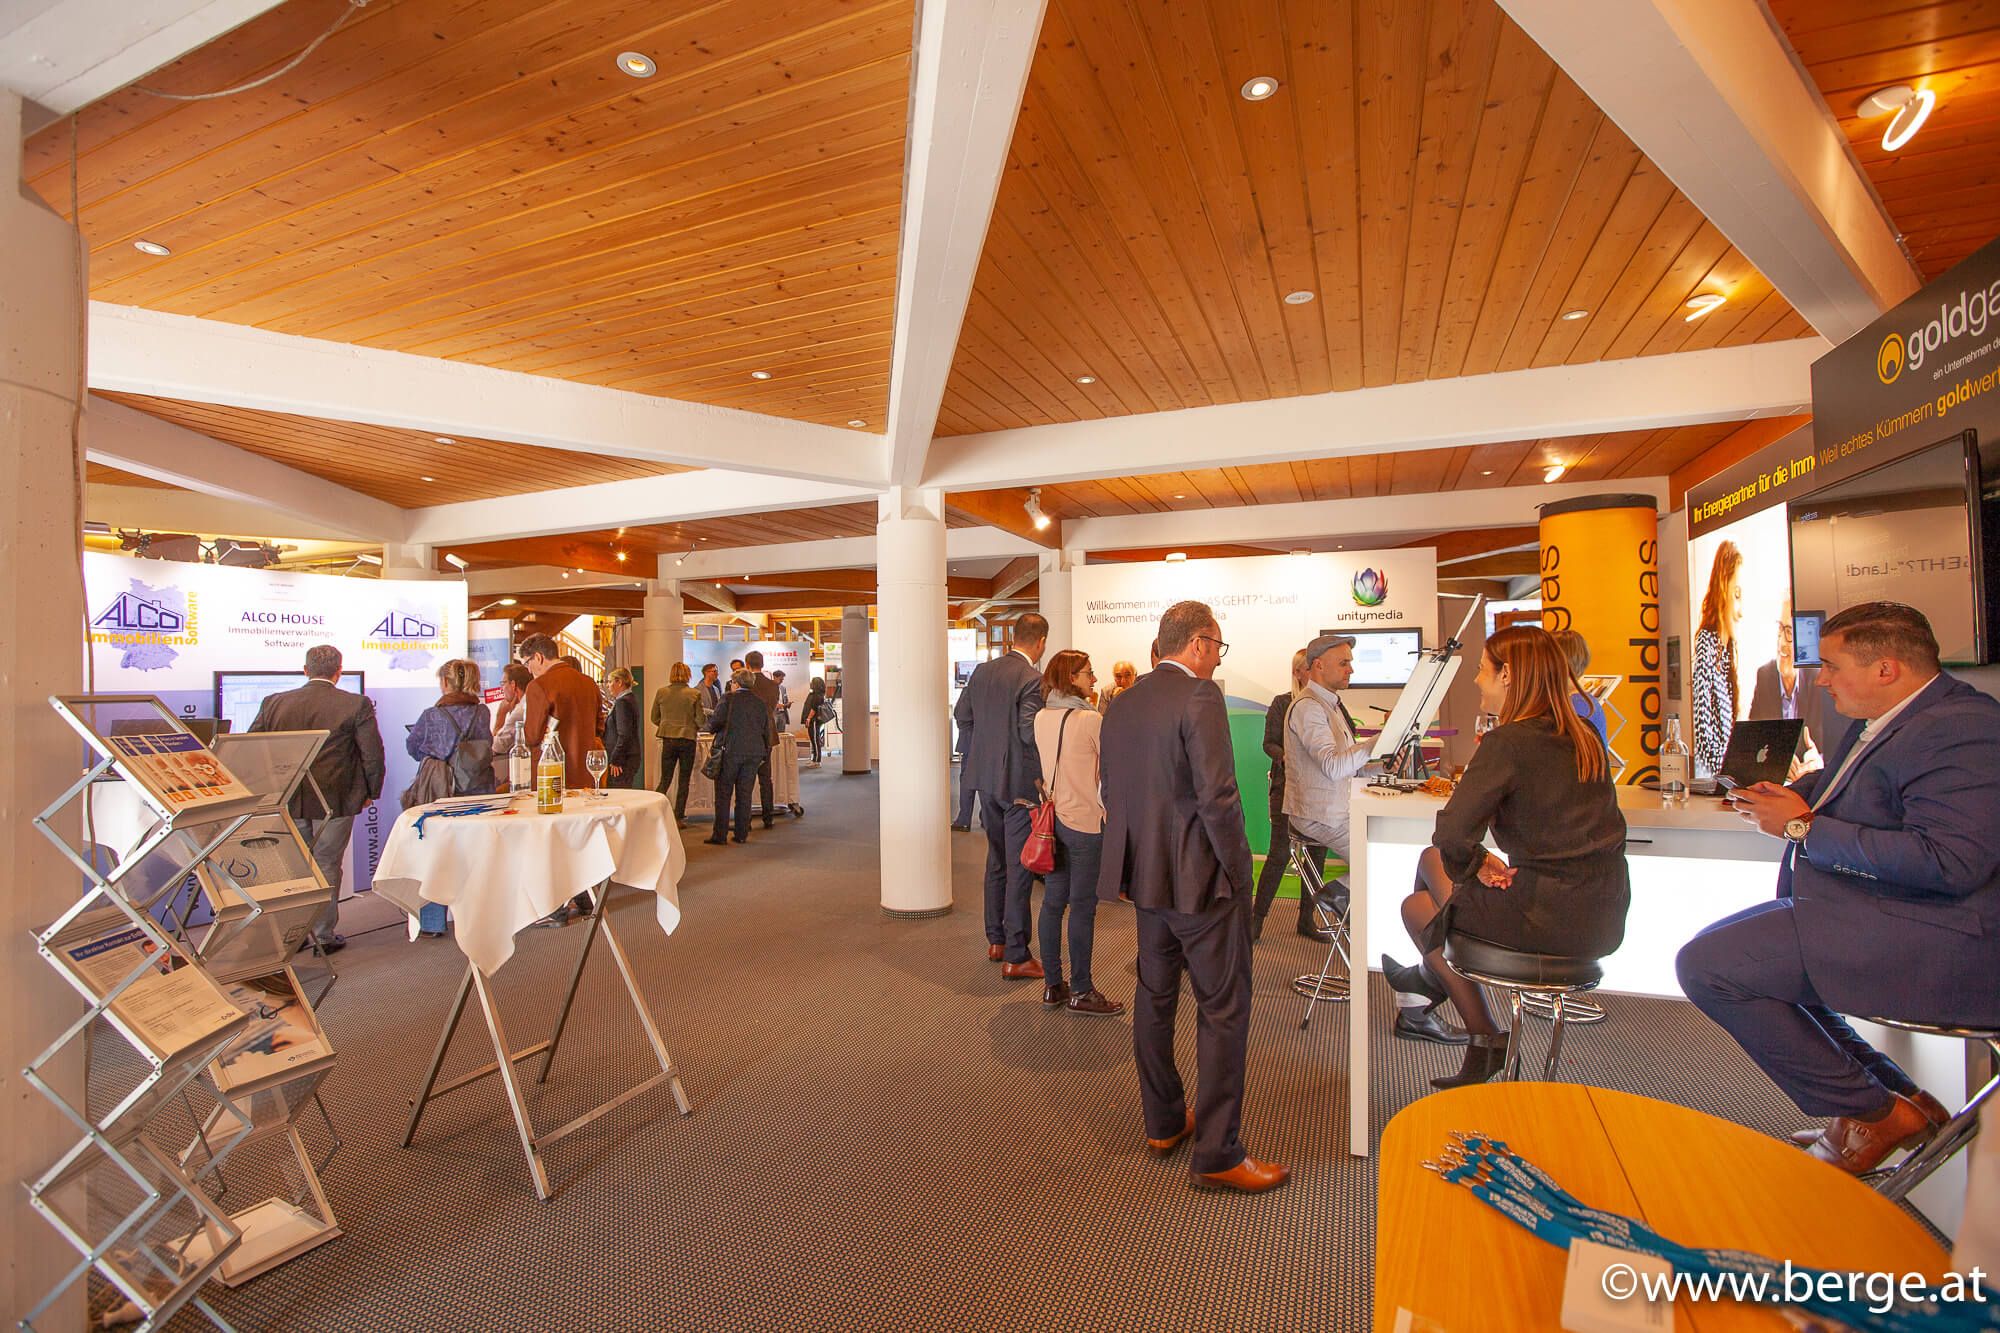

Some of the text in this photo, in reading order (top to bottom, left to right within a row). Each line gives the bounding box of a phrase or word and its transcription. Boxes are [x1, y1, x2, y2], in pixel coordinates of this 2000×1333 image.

[1907, 279, 2000, 371] goldga
[1933, 367, 1943, 380] ein
[1944, 342, 1991, 375] Unternehmen
[1819, 443, 1838, 466] Weil
[1841, 430, 1873, 457] echtes
[1876, 402, 1933, 441] Kümmern
[1693, 507, 1702, 524] Ihr
[1703, 481, 1757, 519] Energiepartner
[1759, 473, 1771, 494] für
[1773, 465, 1789, 487] die
[94, 595, 179, 629] ALCO
[184, 591, 198, 646] Software
[241, 611, 326, 625] ALCO HOUSE
[1086, 600, 1146, 611] Willkommen
[1086, 612, 1147, 624] Willkommen
[1337, 610, 1403, 623] unitymedia
[369, 611, 435, 637] ALCO
[84, 632, 183, 645] Immobilien
[264, 639, 305, 649] Software
